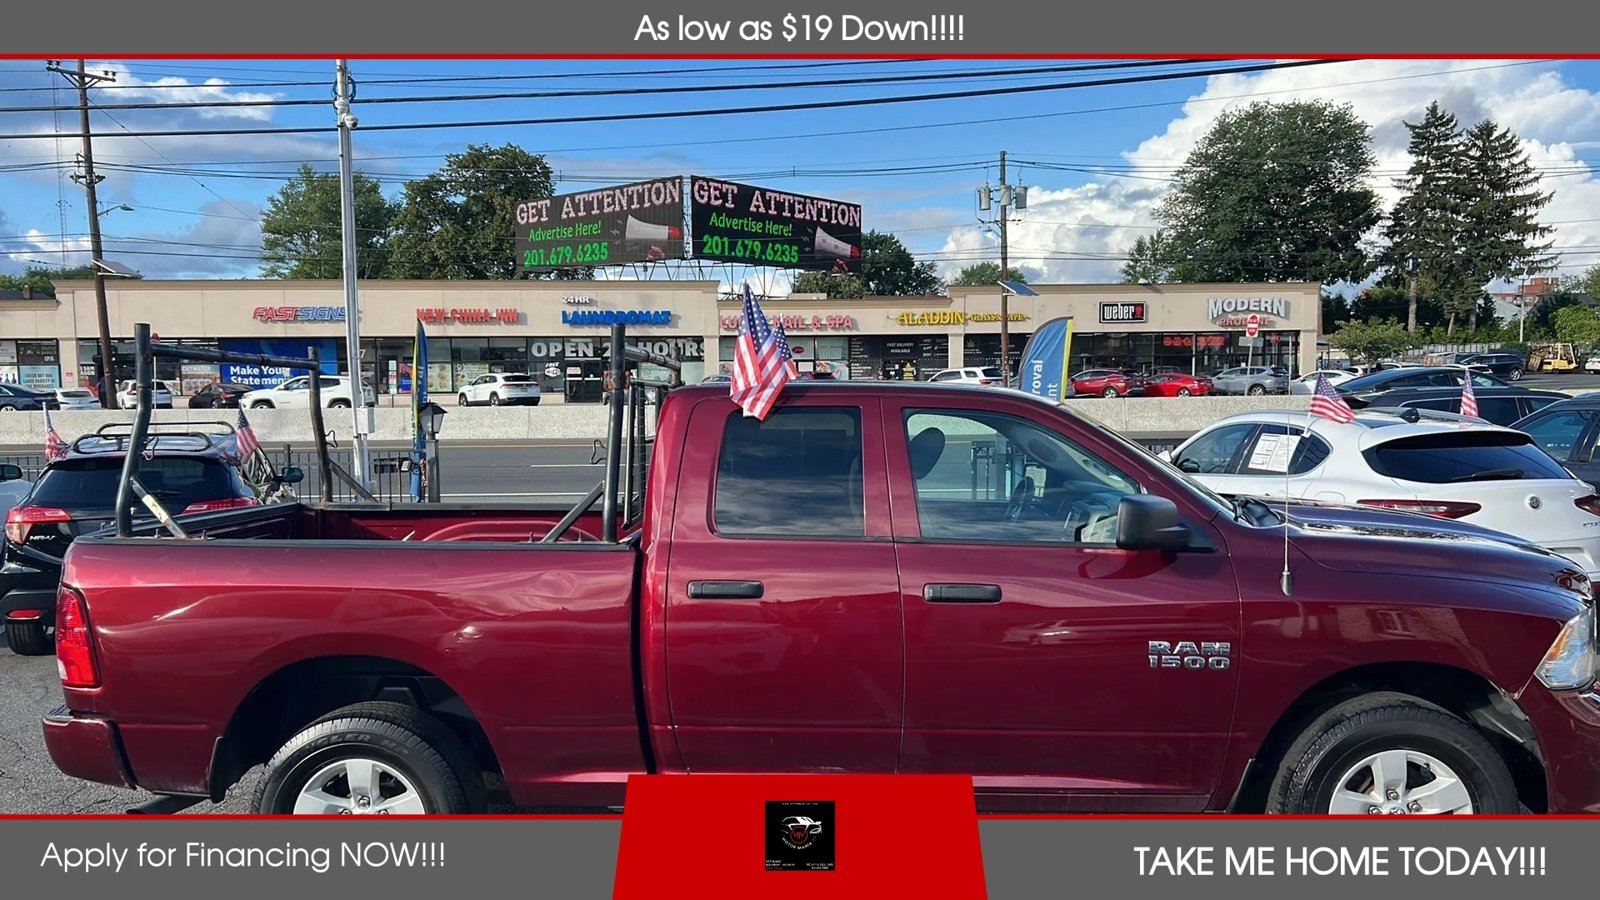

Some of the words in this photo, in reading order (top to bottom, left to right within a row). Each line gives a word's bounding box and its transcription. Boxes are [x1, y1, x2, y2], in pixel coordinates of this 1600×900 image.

[516, 199, 550, 225] GET
[560, 179, 681, 220] ATTENTION
[693, 180, 738, 209] GET
[749, 190, 861, 228] ATTENTION
[528, 226, 573, 243] Advertise
[575, 220, 602, 237] Here!
[709, 212, 763, 233] Advertise
[765, 220, 793, 237] Here!
[523, 242, 609, 268] 201.679.6235
[703, 235, 798, 264] 201.679.6235
[416, 308, 445, 322] NEW
[450, 308, 491, 322] CHINA
[495, 308, 518, 323] INN
[561, 310, 672, 325] LAUNDROMAT
[897, 311, 967, 325] ALADDIN
[1104, 302, 1135, 320] weber
[1208, 298, 1286, 321] MODERN
[811, 316, 821, 328] &
[826, 315, 852, 328] SPA
[531, 342, 594, 358] OPEN
[230, 366, 260, 375] Make
[1148, 640, 1231, 655] RAM
[1148, 654, 1230, 670] 1500
